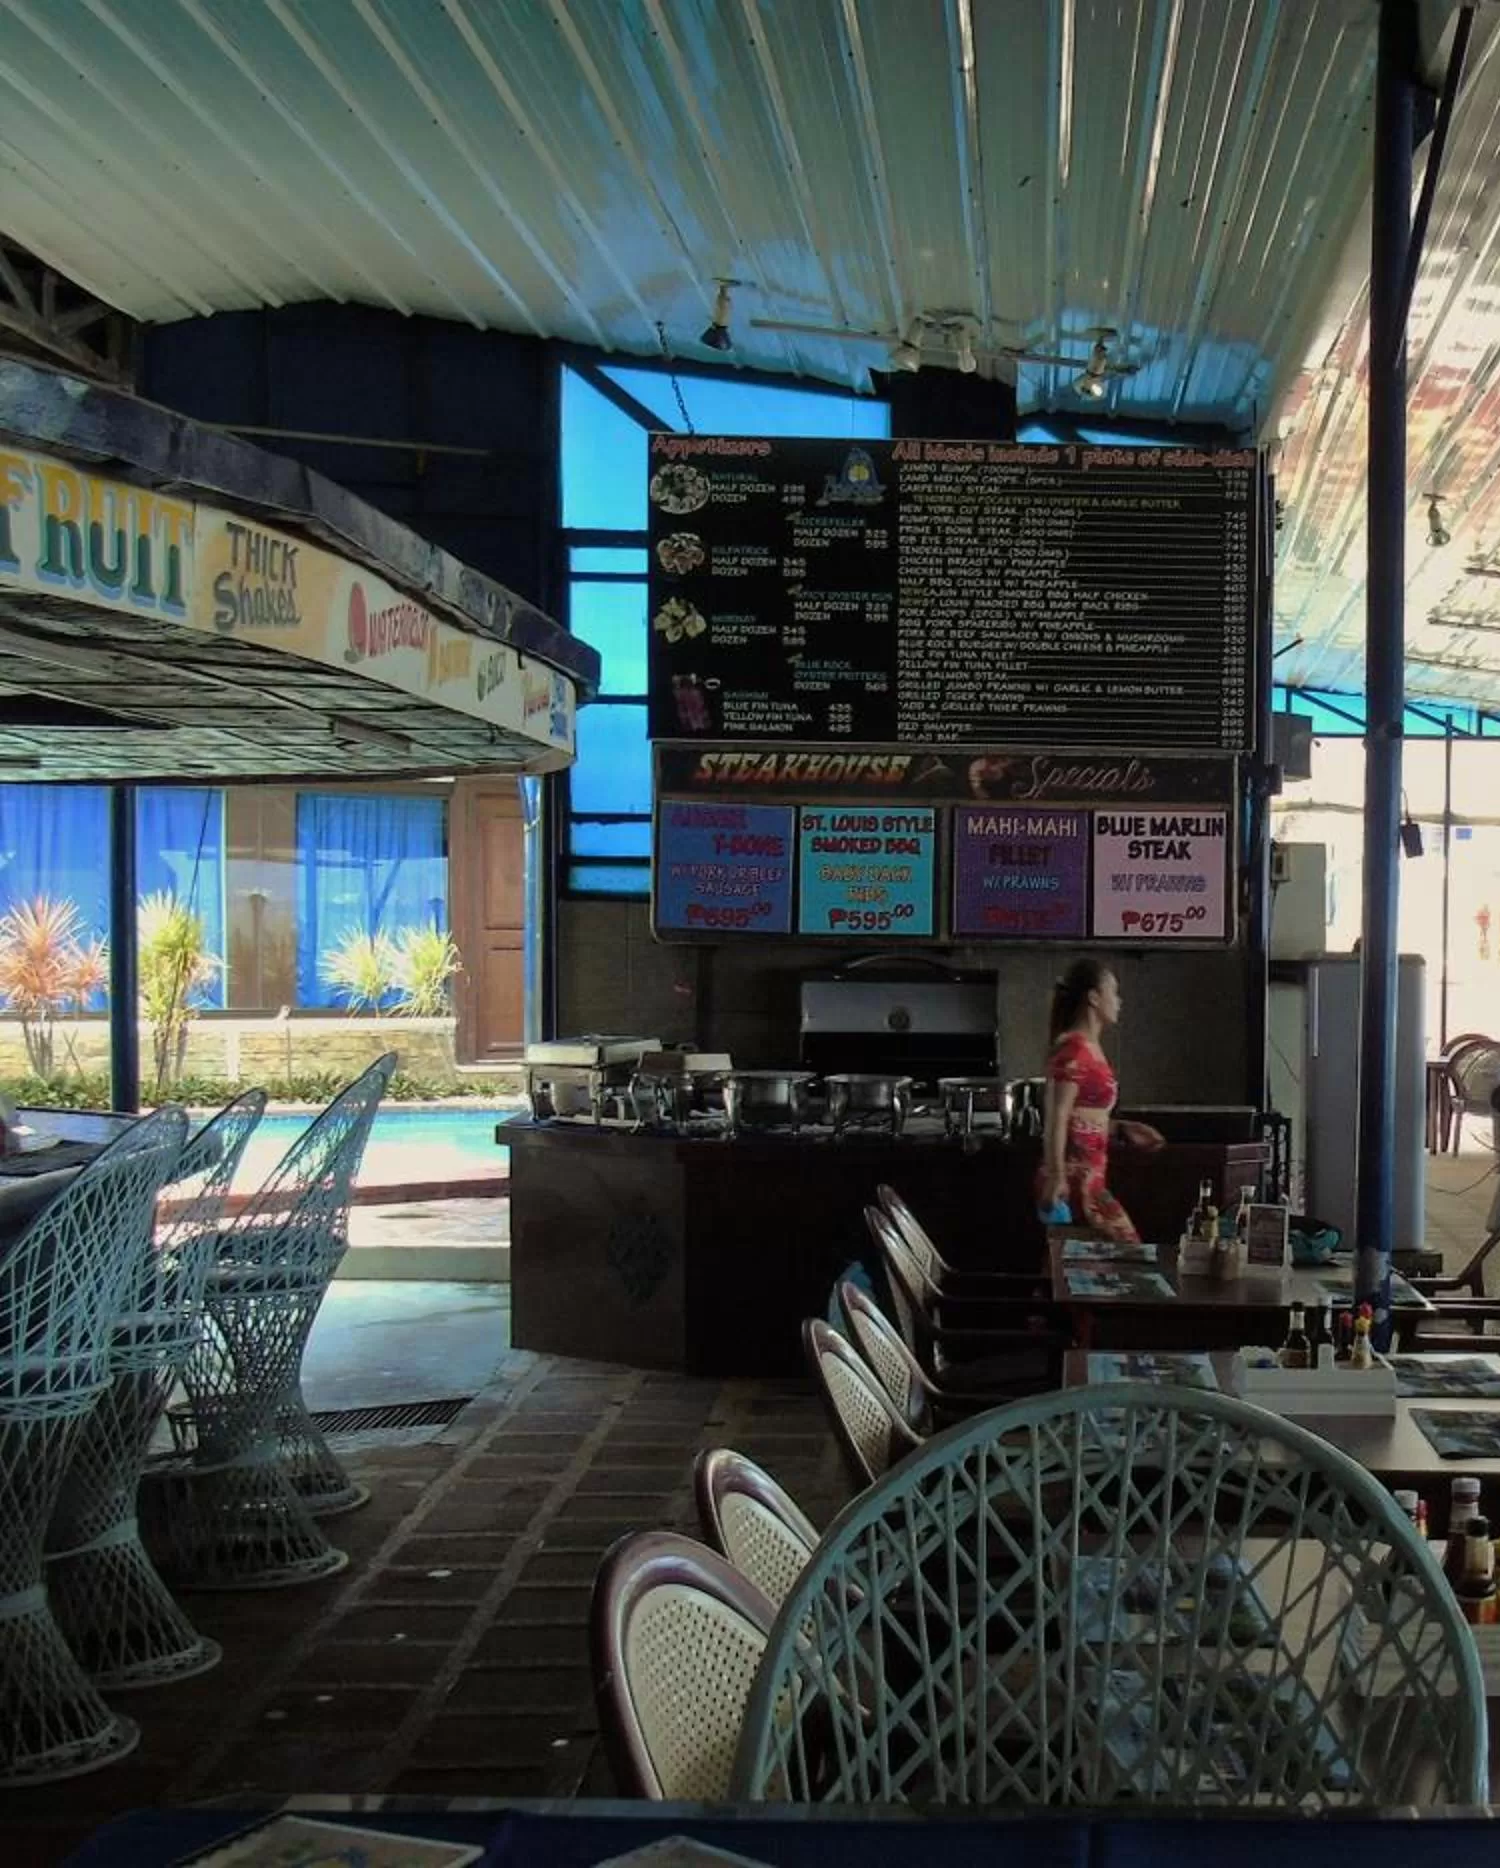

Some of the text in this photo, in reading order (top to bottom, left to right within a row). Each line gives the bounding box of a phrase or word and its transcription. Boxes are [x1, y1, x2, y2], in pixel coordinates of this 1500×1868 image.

[0, 452, 195, 618] FRUIT
[226, 520, 299, 589] THICK
[696, 753, 912, 783] STEAKHOUSE
[1013, 755, 1155, 800] Specials
[832, 815, 879, 833] LOUIS
[880, 815, 934, 834] STYLE
[967, 815, 1079, 839] MAHI-MAHI
[1097, 816, 1224, 837] BLUE MARLIN
[1128, 840, 1191, 861] STEAK
